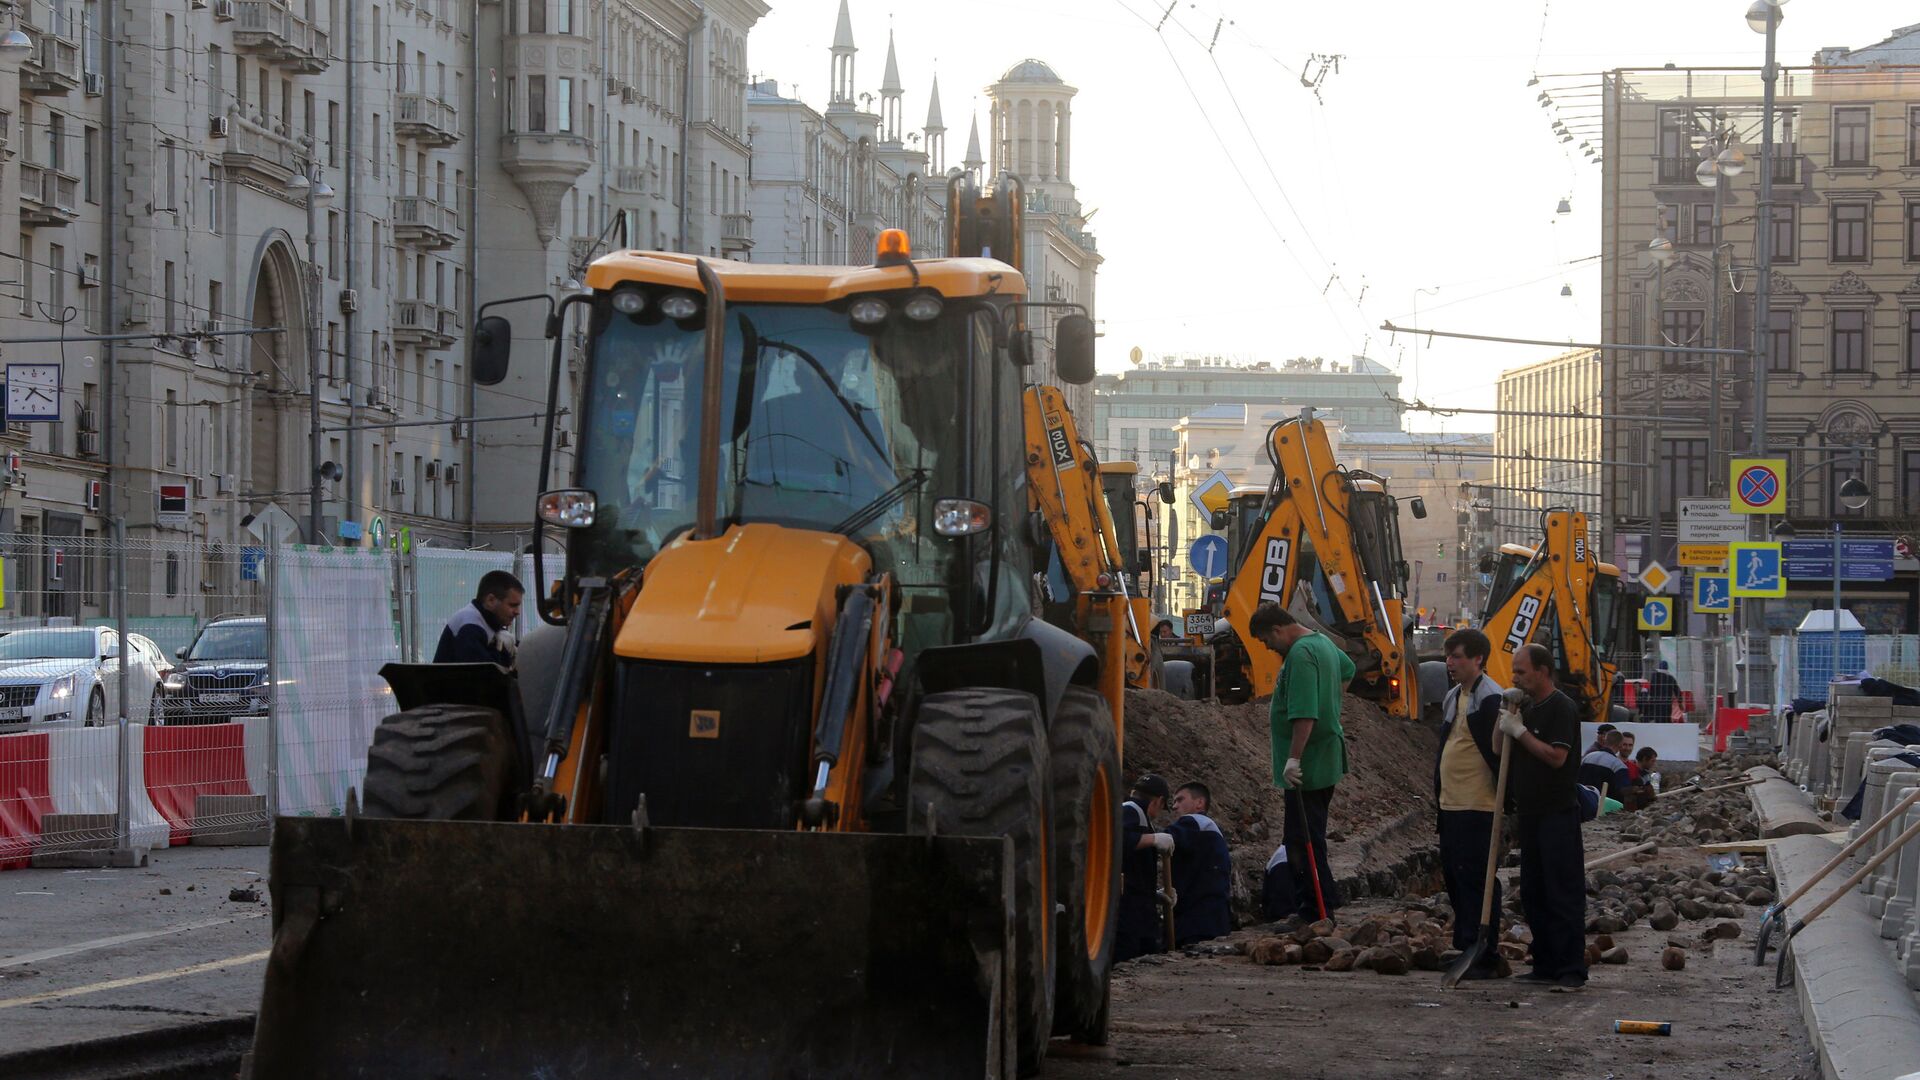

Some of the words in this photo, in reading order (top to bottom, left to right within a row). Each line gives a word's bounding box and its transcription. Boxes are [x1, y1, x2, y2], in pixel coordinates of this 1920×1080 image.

[1051, 430, 1070, 461] 3CX
[1575, 538, 1585, 560] 3CX
[1260, 539, 1289, 606] JCB
[1189, 615, 1211, 624] 3364
[1508, 596, 1540, 653] JCB
